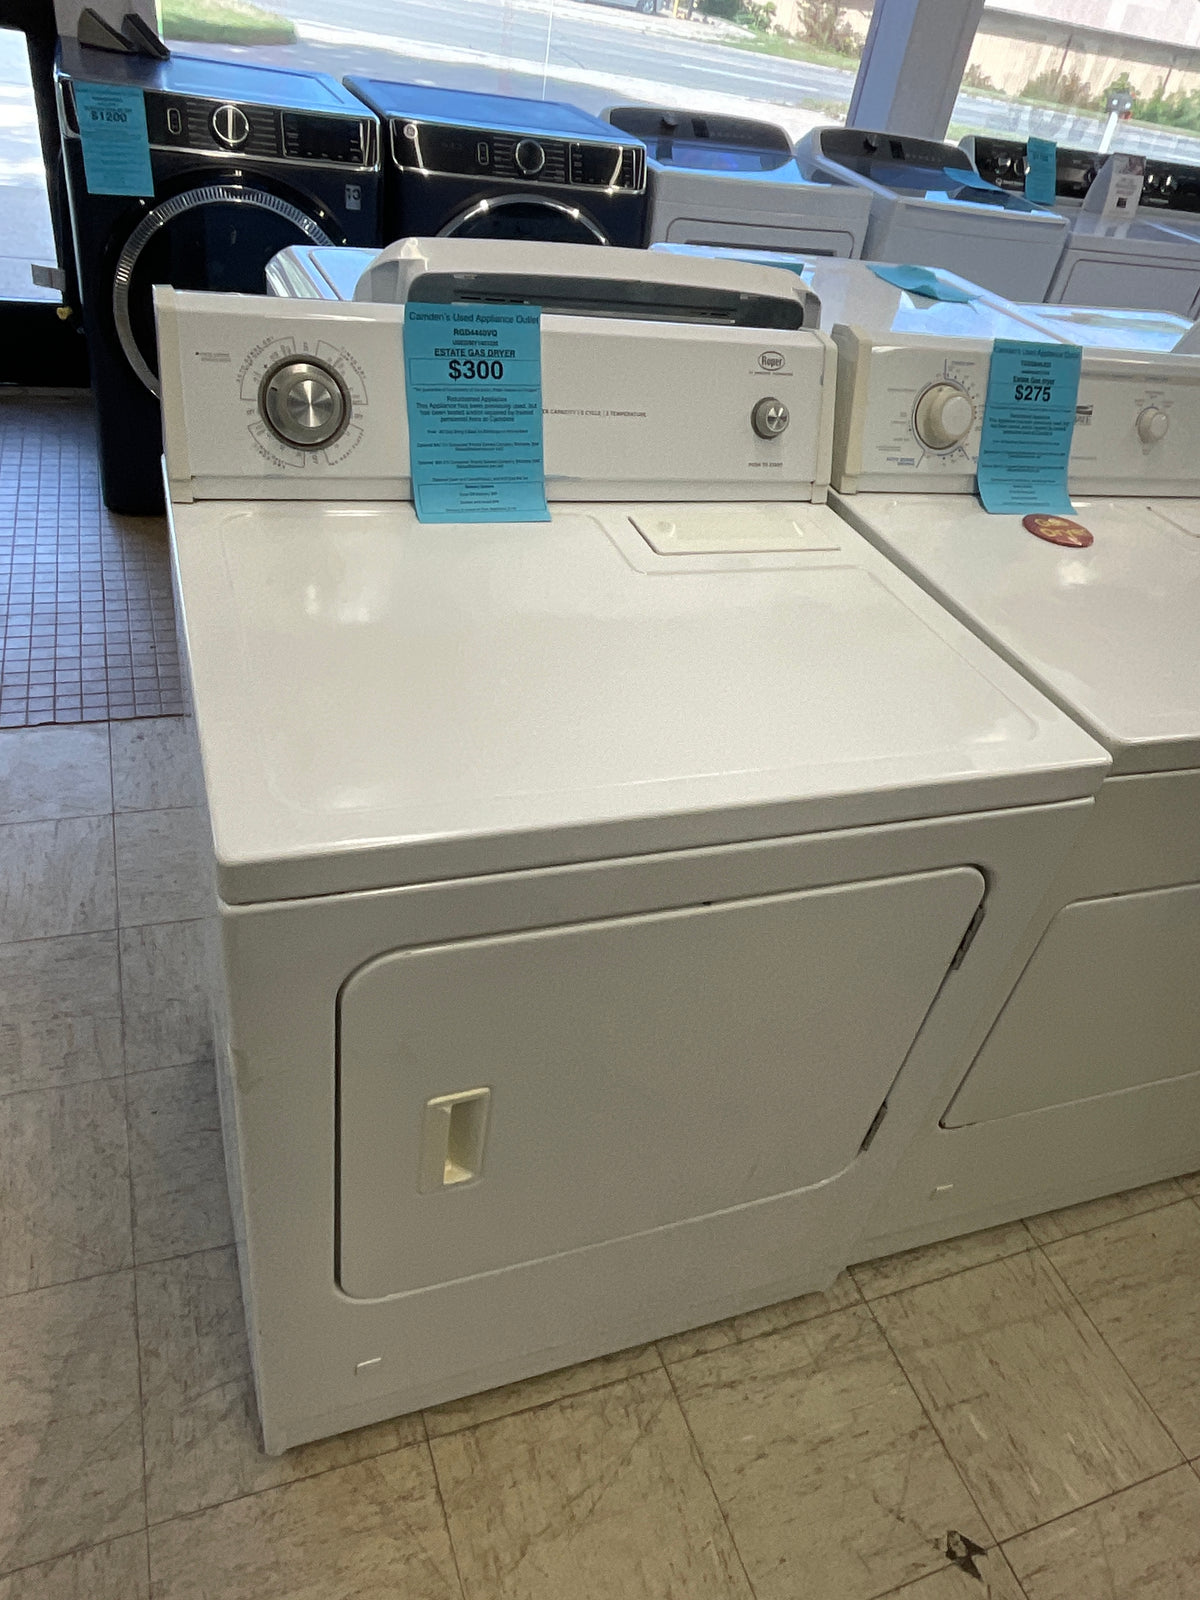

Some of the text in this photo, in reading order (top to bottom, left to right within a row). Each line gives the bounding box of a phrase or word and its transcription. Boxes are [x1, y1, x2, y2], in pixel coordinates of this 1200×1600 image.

[90, 110, 128, 122] $1200
[409, 311, 540, 324] Camden's Used Appliance Outlet
[434, 348, 516, 358] ESTATE GAS DRYER
[761, 355, 783, 367] Roper
[448, 359, 504, 381] $300
[1014, 384, 1052, 402] $275
